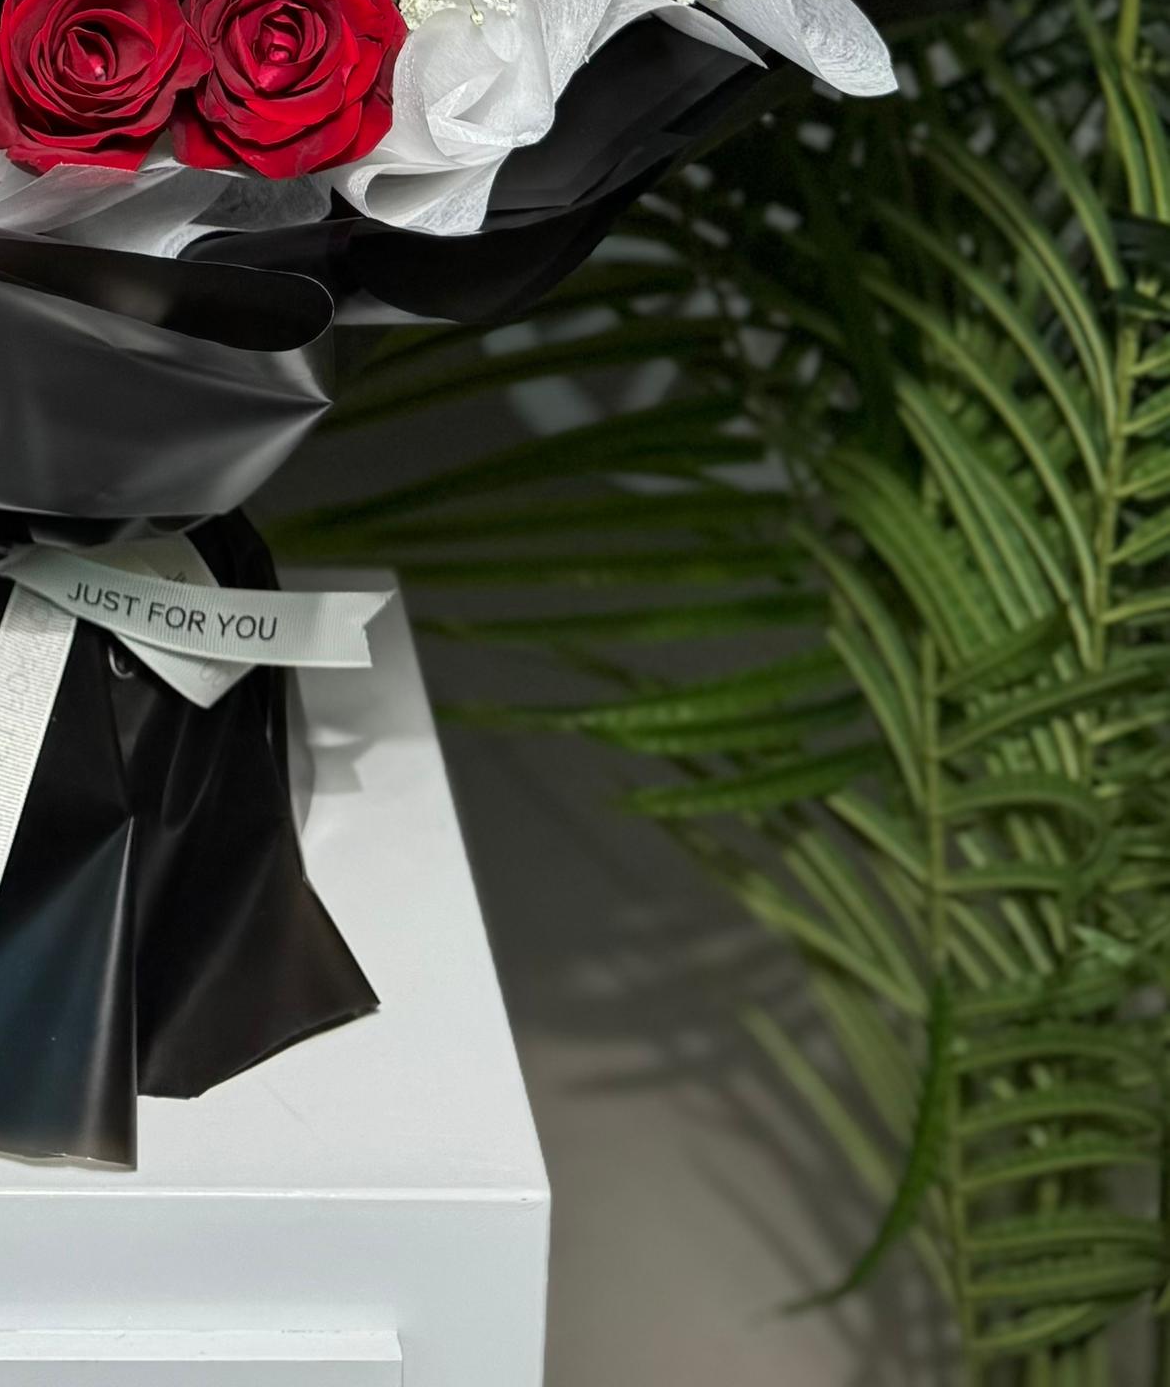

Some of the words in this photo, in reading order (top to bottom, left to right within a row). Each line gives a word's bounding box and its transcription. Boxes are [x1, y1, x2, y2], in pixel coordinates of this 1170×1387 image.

[66, 581, 141, 617] JUST
[147, 601, 207, 636] FOR
[217, 613, 278, 641] YOU
